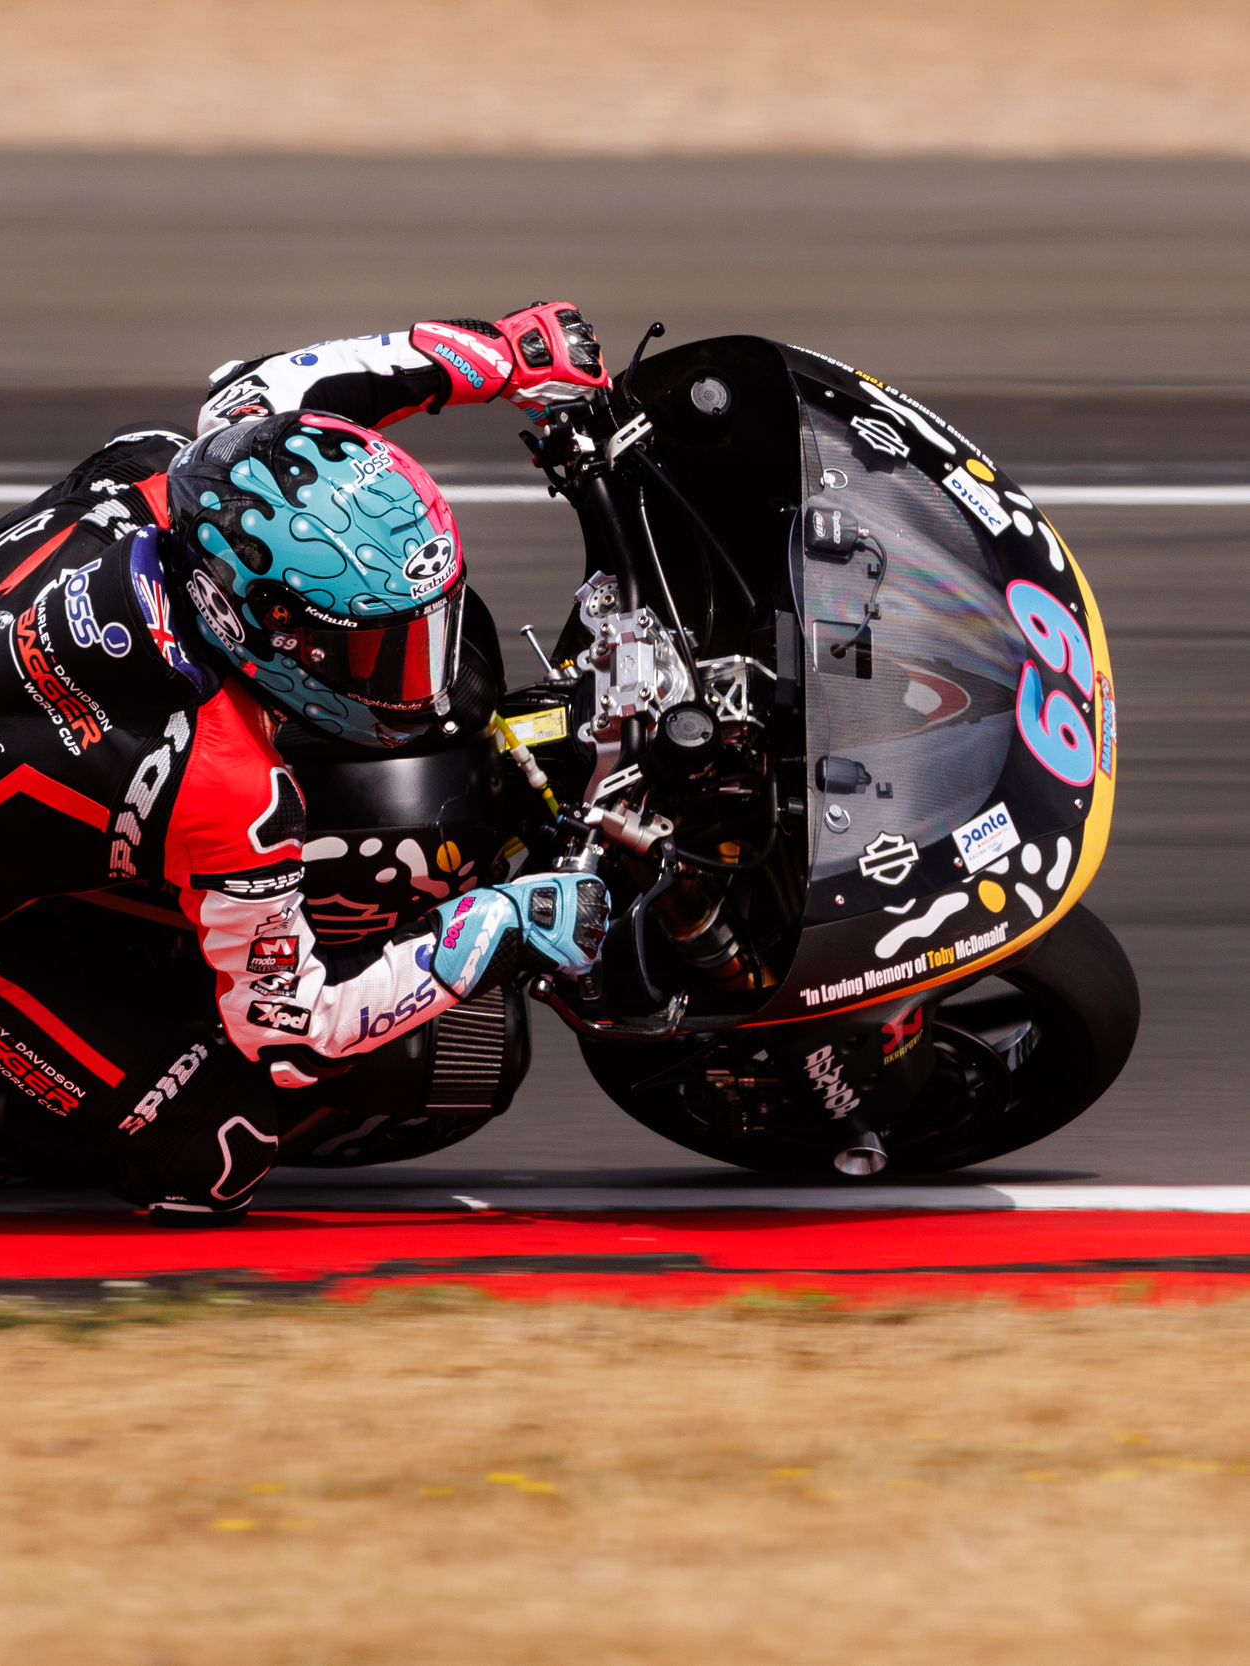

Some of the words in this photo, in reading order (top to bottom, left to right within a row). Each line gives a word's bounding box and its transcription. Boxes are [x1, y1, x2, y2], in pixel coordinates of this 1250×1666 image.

[434, 342, 484, 389] MADDOG
[412, 563, 457, 597] Kabuto
[272, 635, 298, 650] 69
[304, 605, 359, 628] Kabuto
[17, 603, 102, 750] BAGGER
[1006, 579, 1096, 787] 69
[24, 682, 63, 726] WORLD
[59, 724, 81, 756] CUP
[1100, 699, 1111, 775] MADDOG
[821, 976, 863, 1003] Loving
[864, 959, 913, 990] Memory
[914, 954, 928, 974] of
[927, 947, 955, 969] Toby
[37, 1097, 68, 1117] CUP
[802, 1044, 861, 1120] DUNLOP
